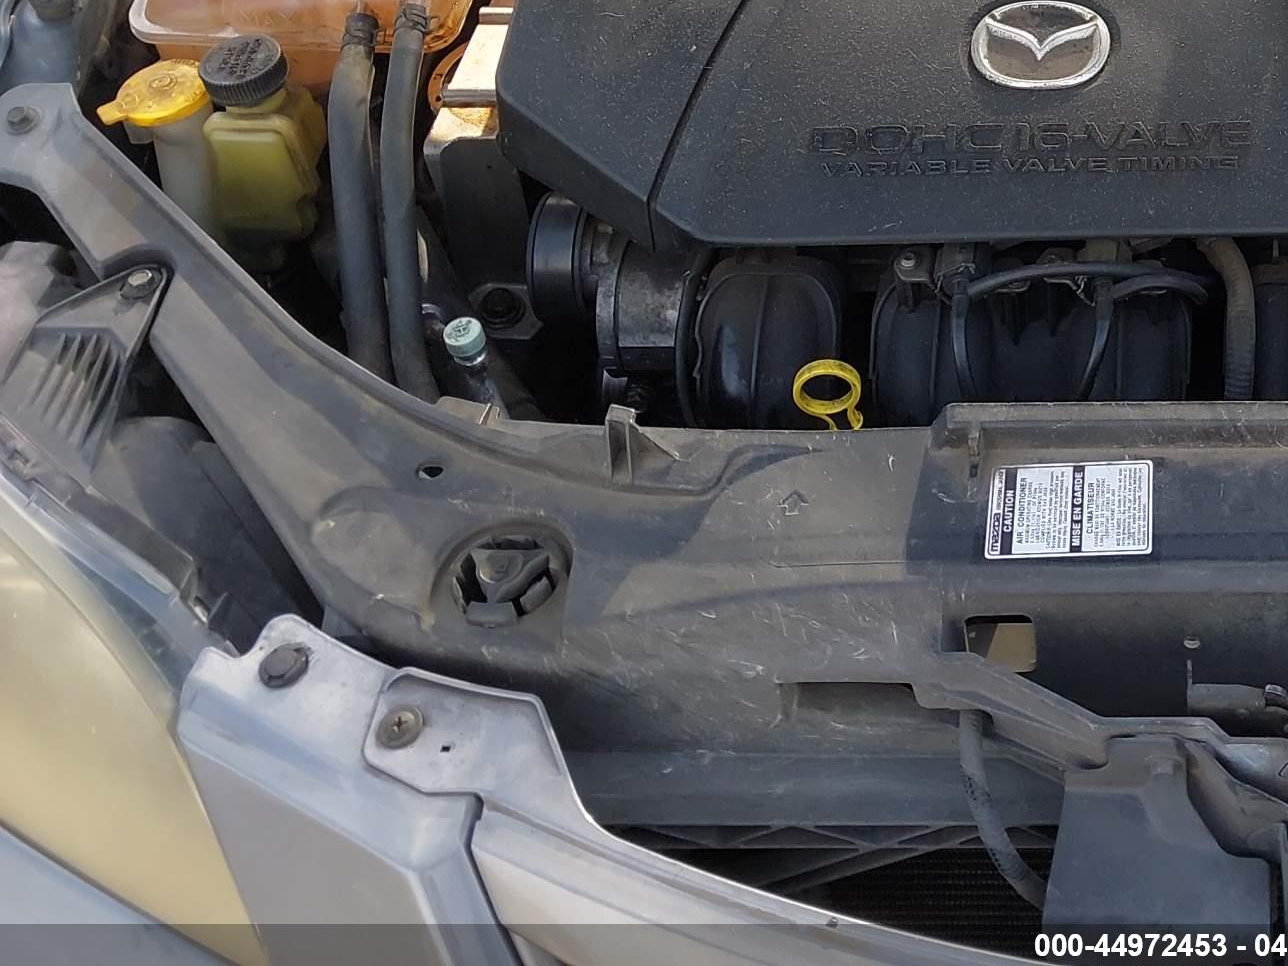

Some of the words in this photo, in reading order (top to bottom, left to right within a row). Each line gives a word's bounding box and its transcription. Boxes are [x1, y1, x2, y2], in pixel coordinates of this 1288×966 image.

[820, 158, 994, 178] VARIABLE
[1002, 156, 1109, 174] VALVE
[1118, 155, 1240, 173] TIMING
[1017, 477, 1028, 528] CONDITIONER
[1073, 471, 1083, 505] GARDE
[1003, 489, 1015, 533] CAUTION
[1072, 507, 1081, 520] EN
[1086, 482, 1095, 534] CLIMATISEUR
[990, 513, 1001, 552] mazda
[1016, 531, 1024, 544] AIR
[1072, 522, 1081, 547] MISE
